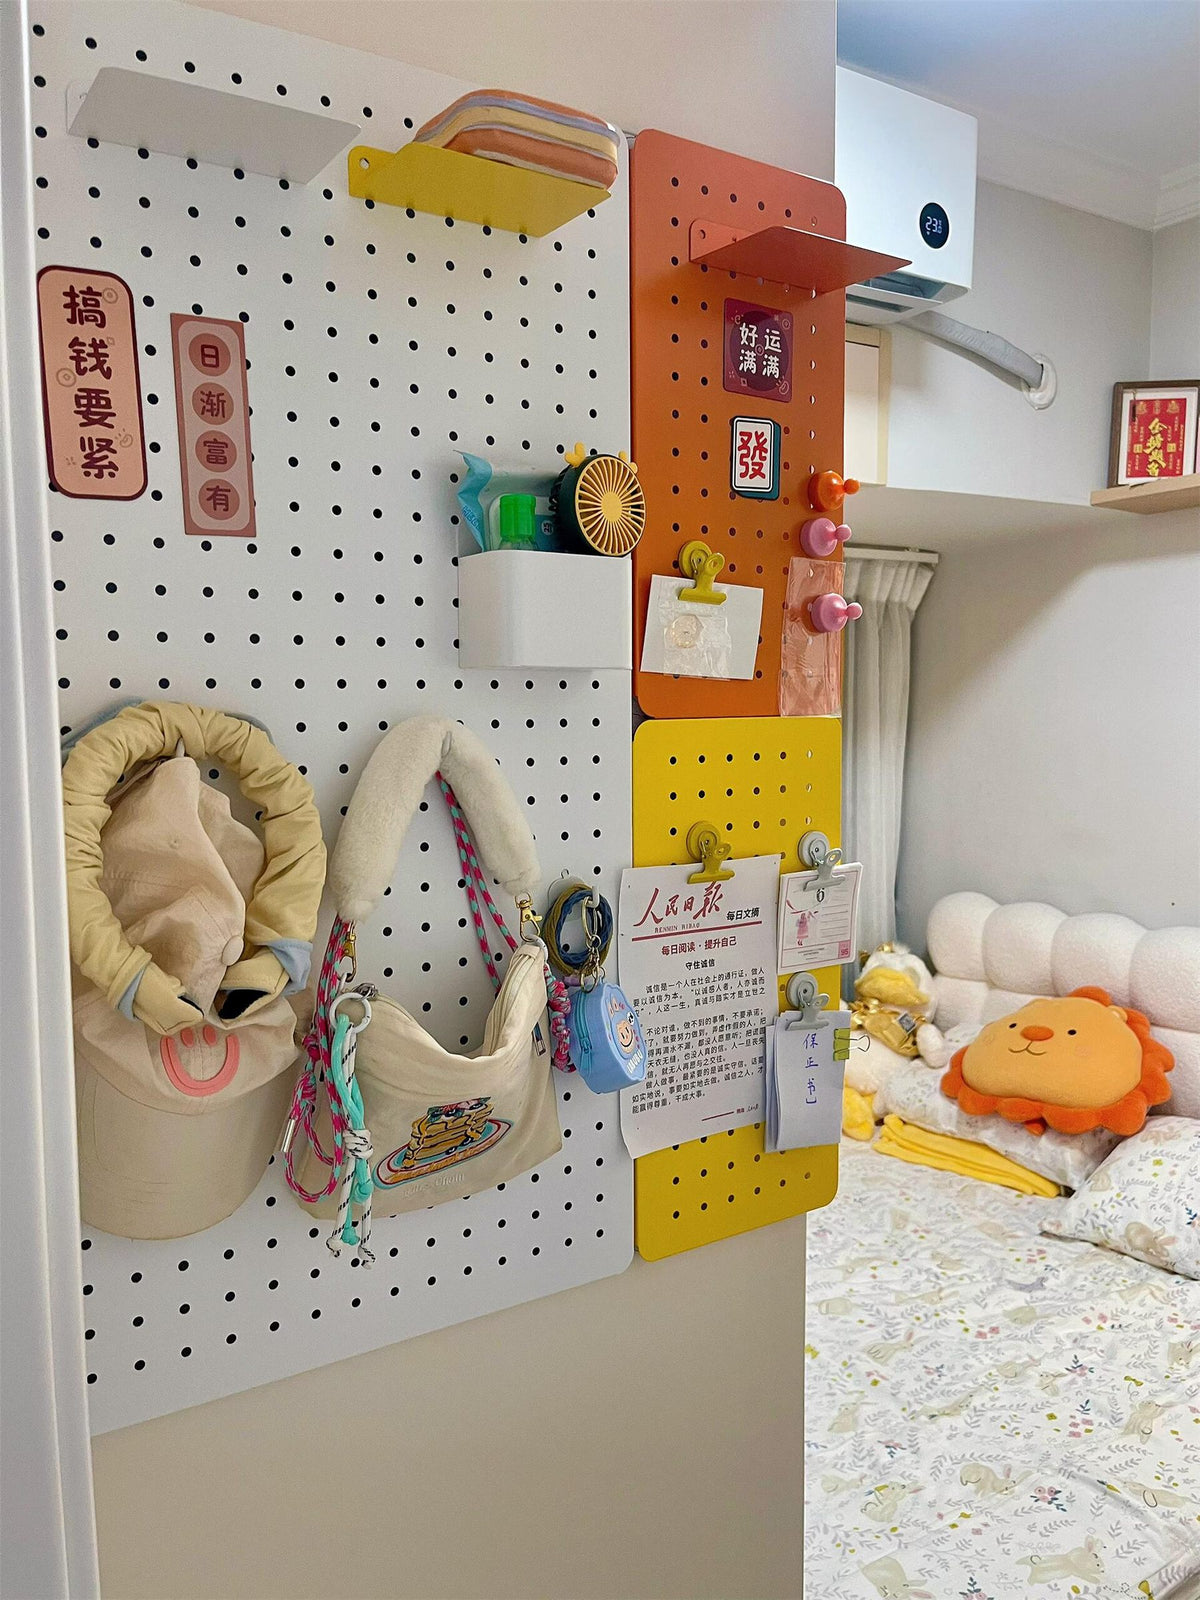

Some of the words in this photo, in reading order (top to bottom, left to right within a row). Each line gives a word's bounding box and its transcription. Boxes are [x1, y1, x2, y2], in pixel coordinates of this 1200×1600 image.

[740, 322, 782, 353] 好运
[62, 285, 119, 479] 搞钱要紧
[739, 349, 780, 379] 满满
[199, 344, 232, 513] 日渐富有
[737, 430, 769, 480] 發
[633, 880, 723, 927] 人民日报
[726, 907, 760, 921] 每日文摘
[685, 958, 716, 971] 守住诚信
